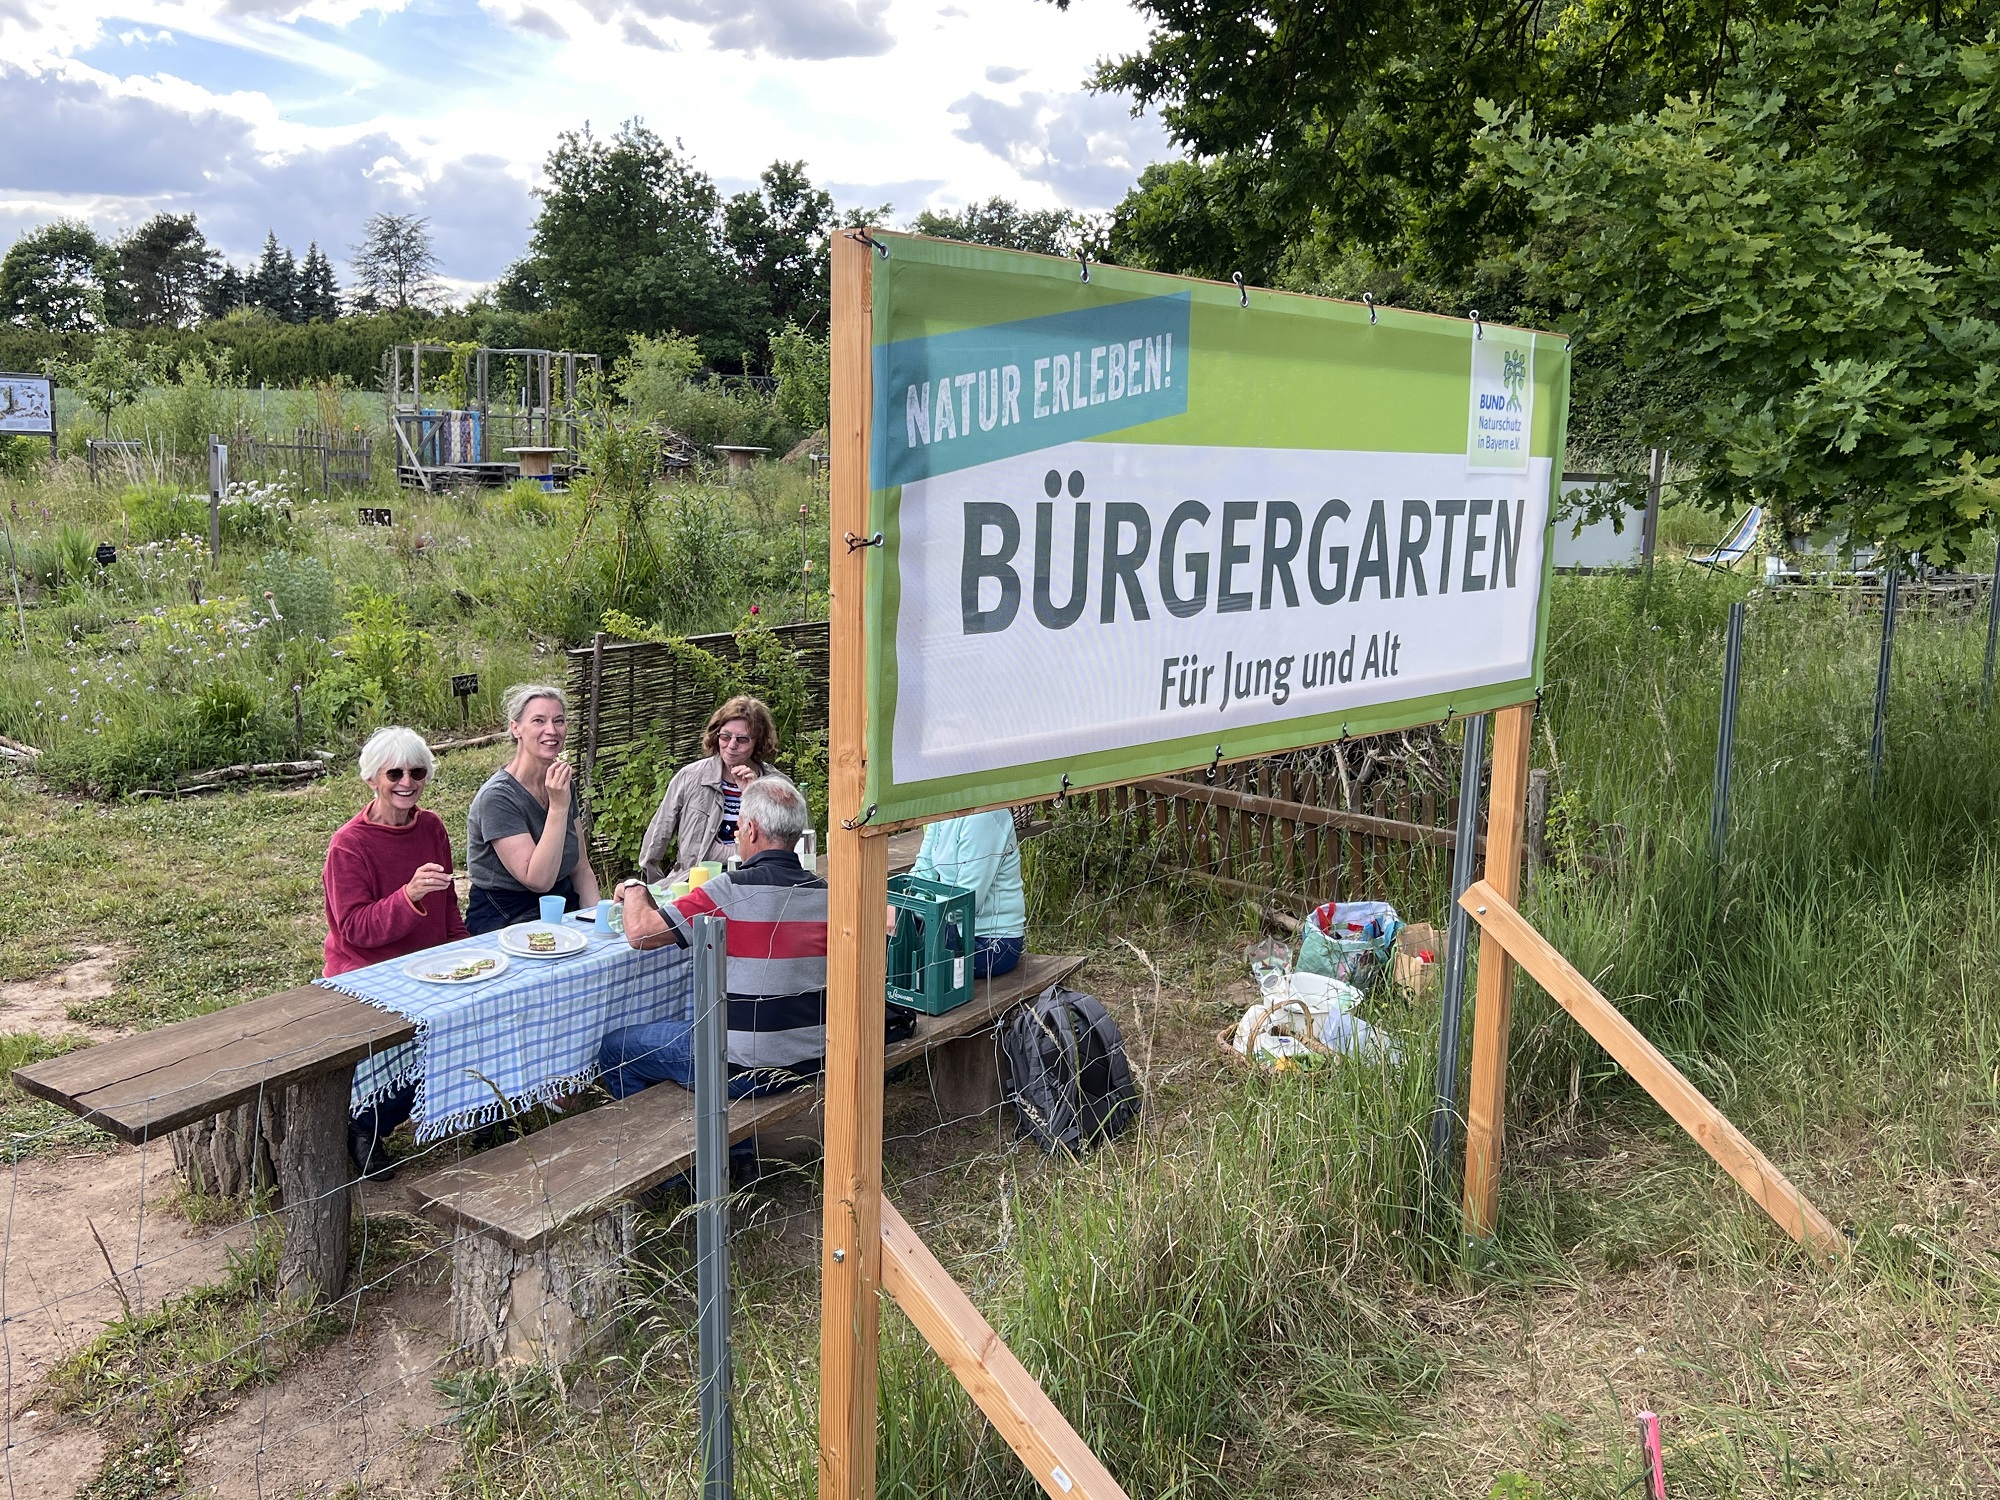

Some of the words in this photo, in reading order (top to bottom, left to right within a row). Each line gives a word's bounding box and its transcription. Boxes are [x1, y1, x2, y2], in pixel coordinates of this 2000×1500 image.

[905, 364, 1021, 448] NATUR
[1033, 332, 1172, 419] ERLEBEN!
[1480, 394, 1505, 411] BUND
[1477, 435, 1485, 449] in
[1485, 435, 1509, 453] Bayern
[1509, 437, 1520, 450] e.V.
[1479, 415, 1522, 432] Naturschutz
[961, 469, 1525, 635] BÜRGERGARTEN
[1159, 653, 1215, 711] Für
[1219, 651, 1296, 713] Jung
[1302, 634, 1357, 690] und
[1360, 630, 1402, 681] Alt
